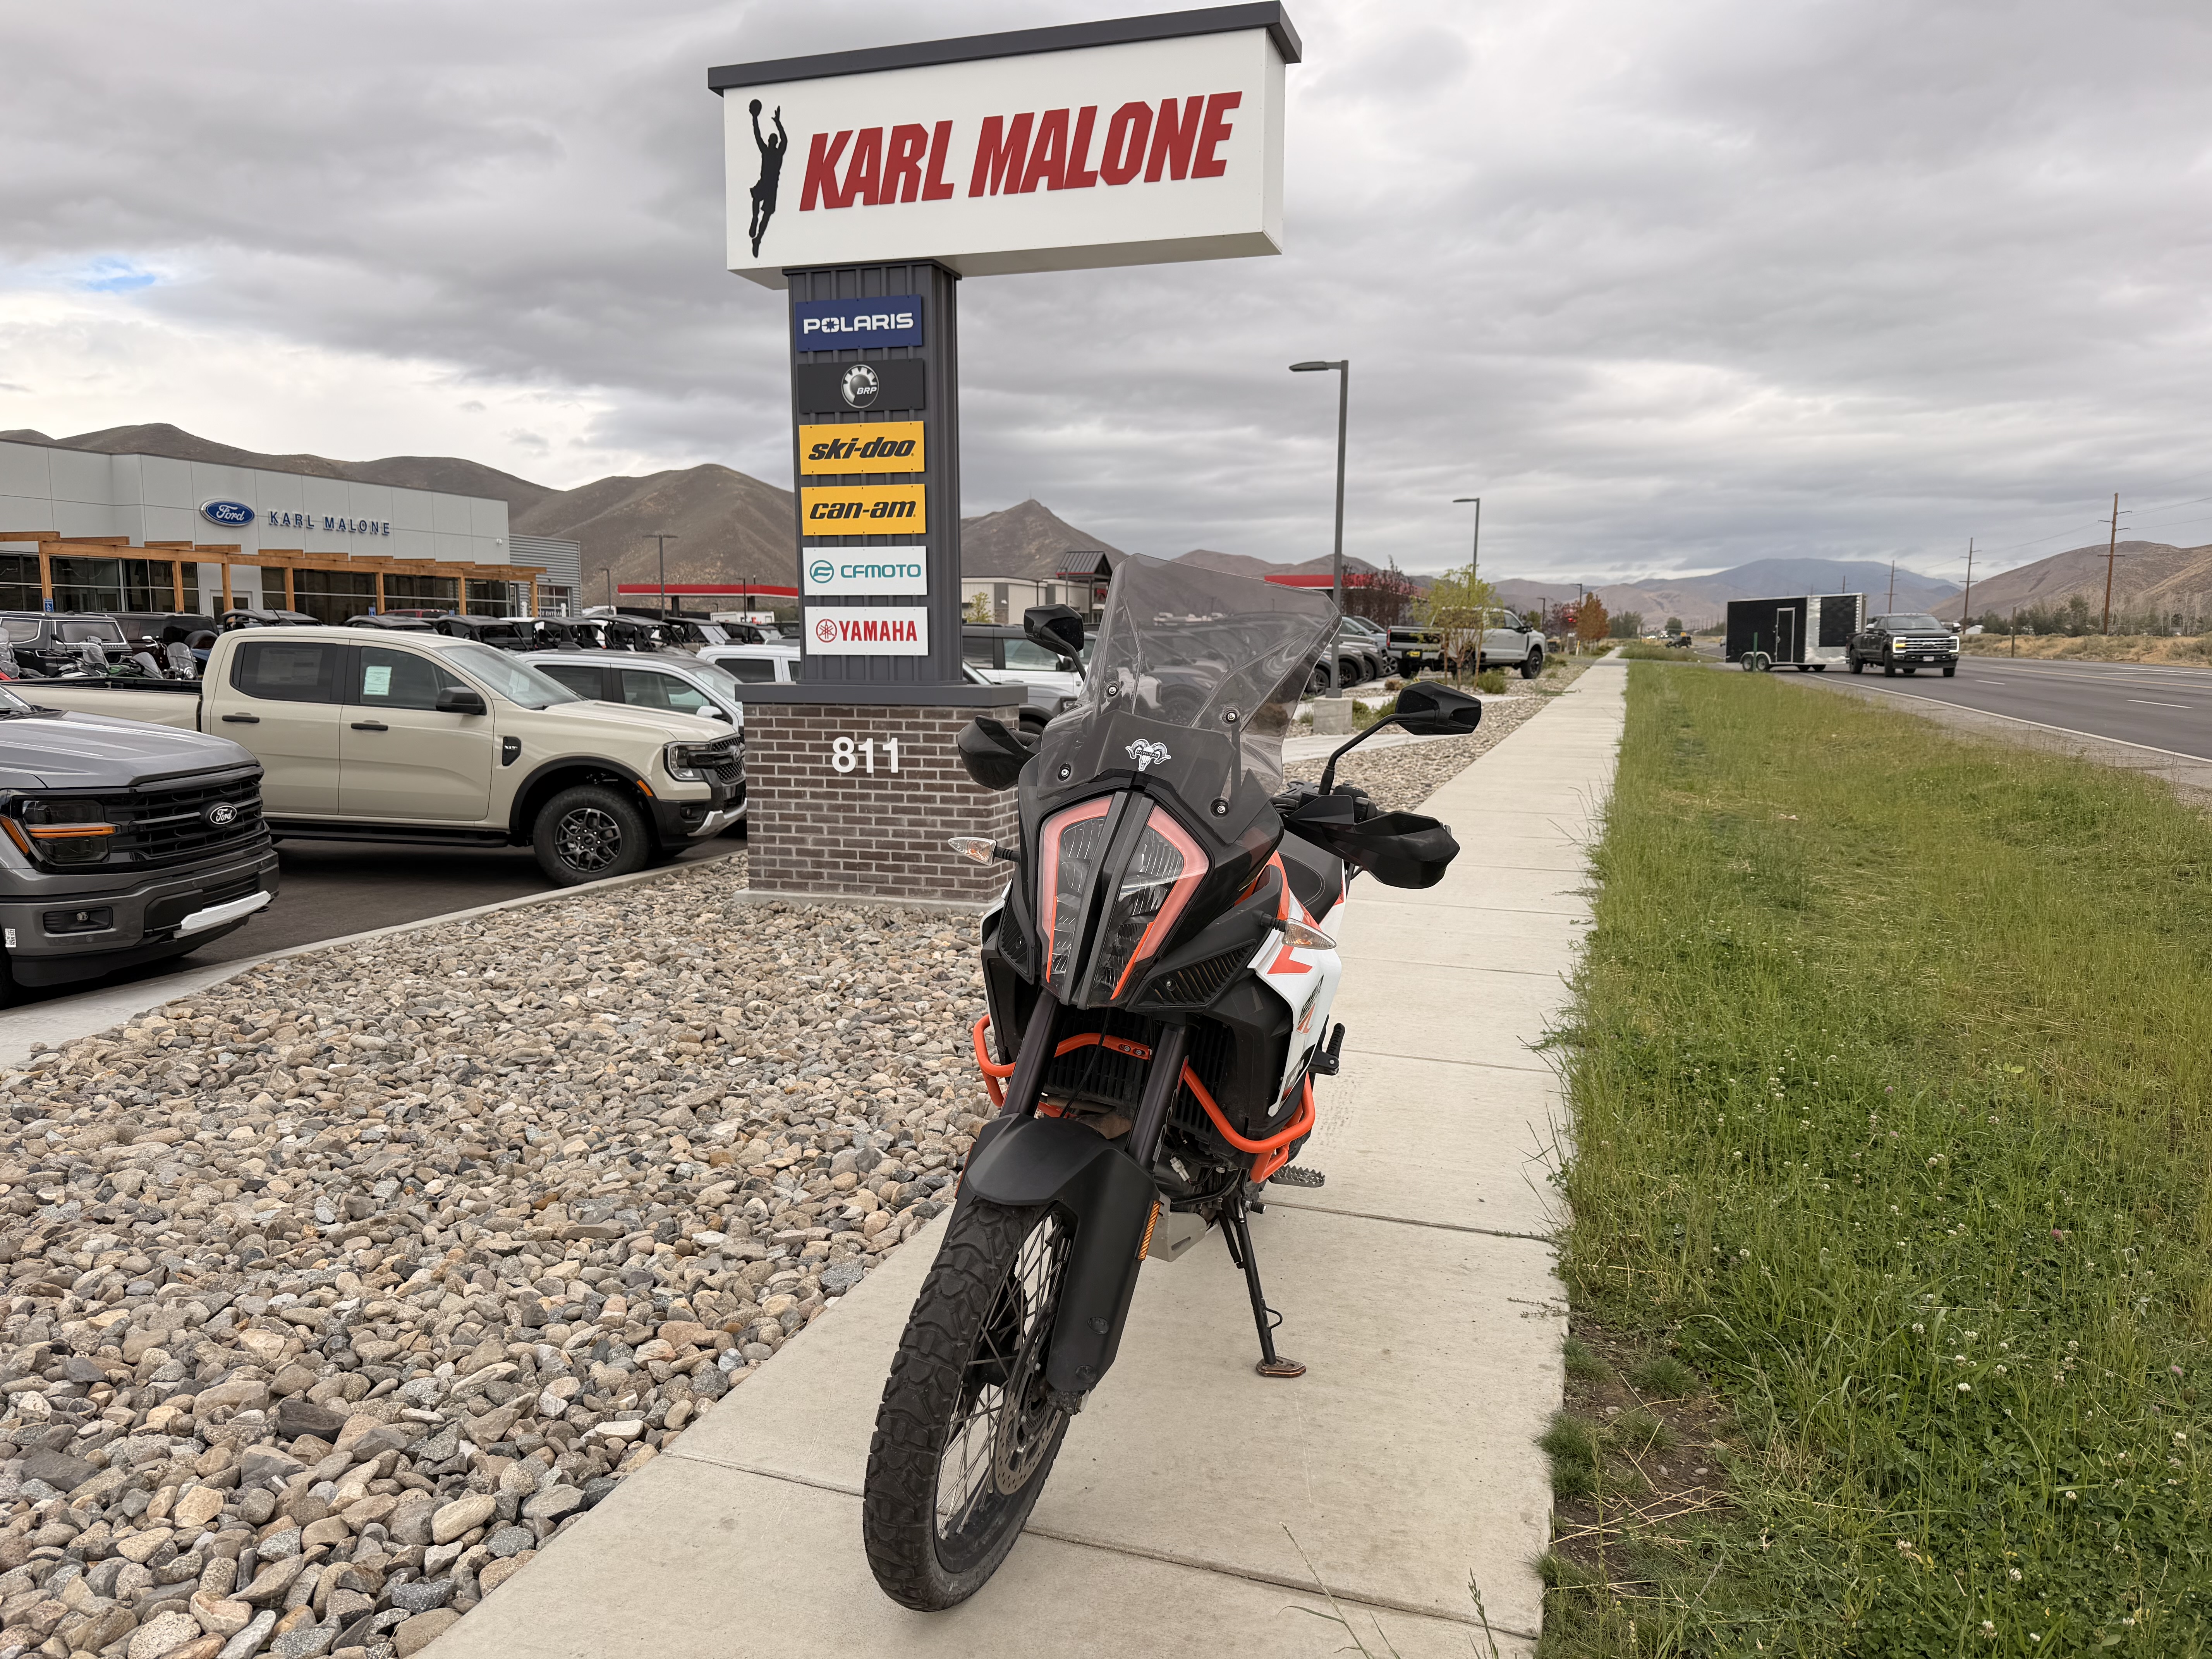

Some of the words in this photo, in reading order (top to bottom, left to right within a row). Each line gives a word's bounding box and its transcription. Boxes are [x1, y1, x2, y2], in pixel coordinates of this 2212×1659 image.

[800, 120, 954, 211] KARL
[968, 91, 1242, 198] MALONE
[804, 313, 914, 334] POLARIS
[808, 437, 916, 460] ski-doo
[216, 505, 245, 521] Ford
[810, 501, 916, 519] can-am
[268, 510, 314, 528] KARL
[324, 515, 390, 535] MALONE
[841, 564, 921, 578] CFMOTO
[839, 621, 917, 641] YAMAHA
[832, 737, 898, 773] 811
[216, 808, 232, 822] Ford
